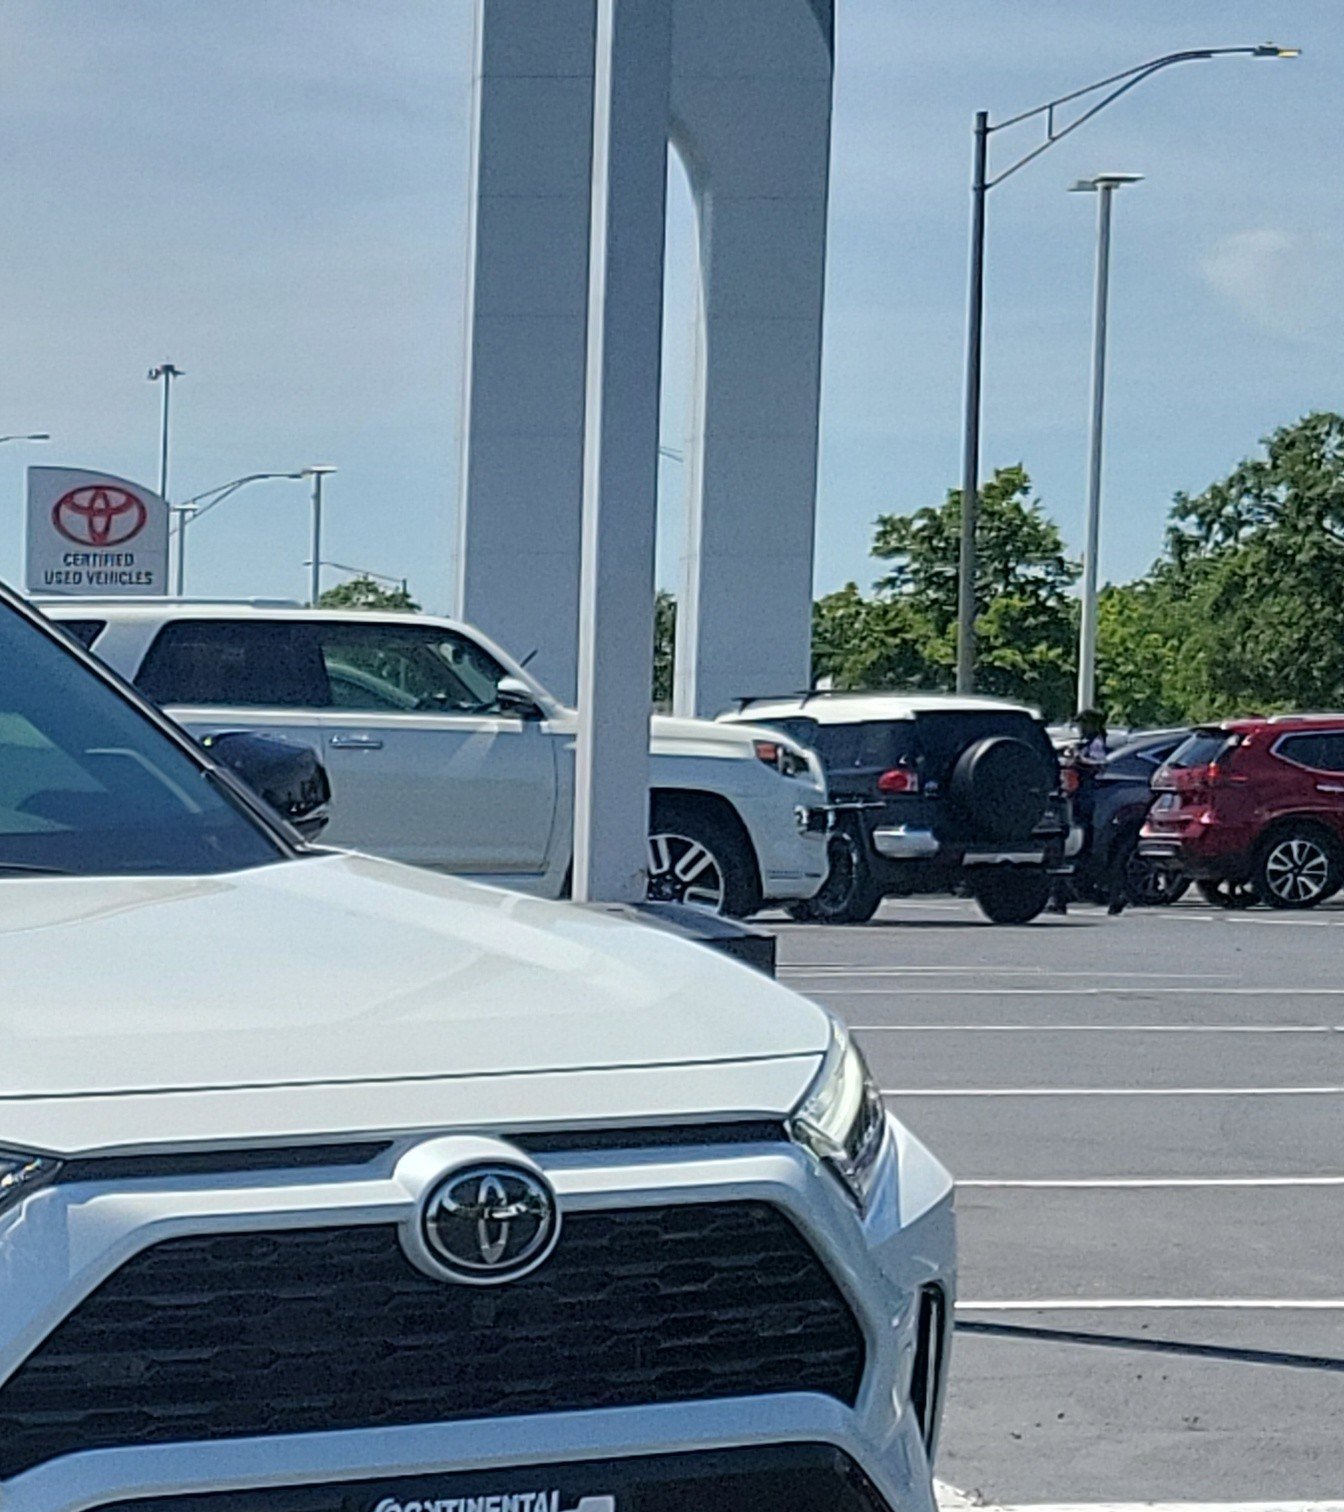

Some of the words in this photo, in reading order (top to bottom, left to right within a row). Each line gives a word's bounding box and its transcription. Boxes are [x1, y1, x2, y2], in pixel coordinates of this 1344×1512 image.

[63, 553, 134, 567] CERTIFIED
[44, 571, 82, 585] USED
[87, 571, 154, 585] VEHICLES
